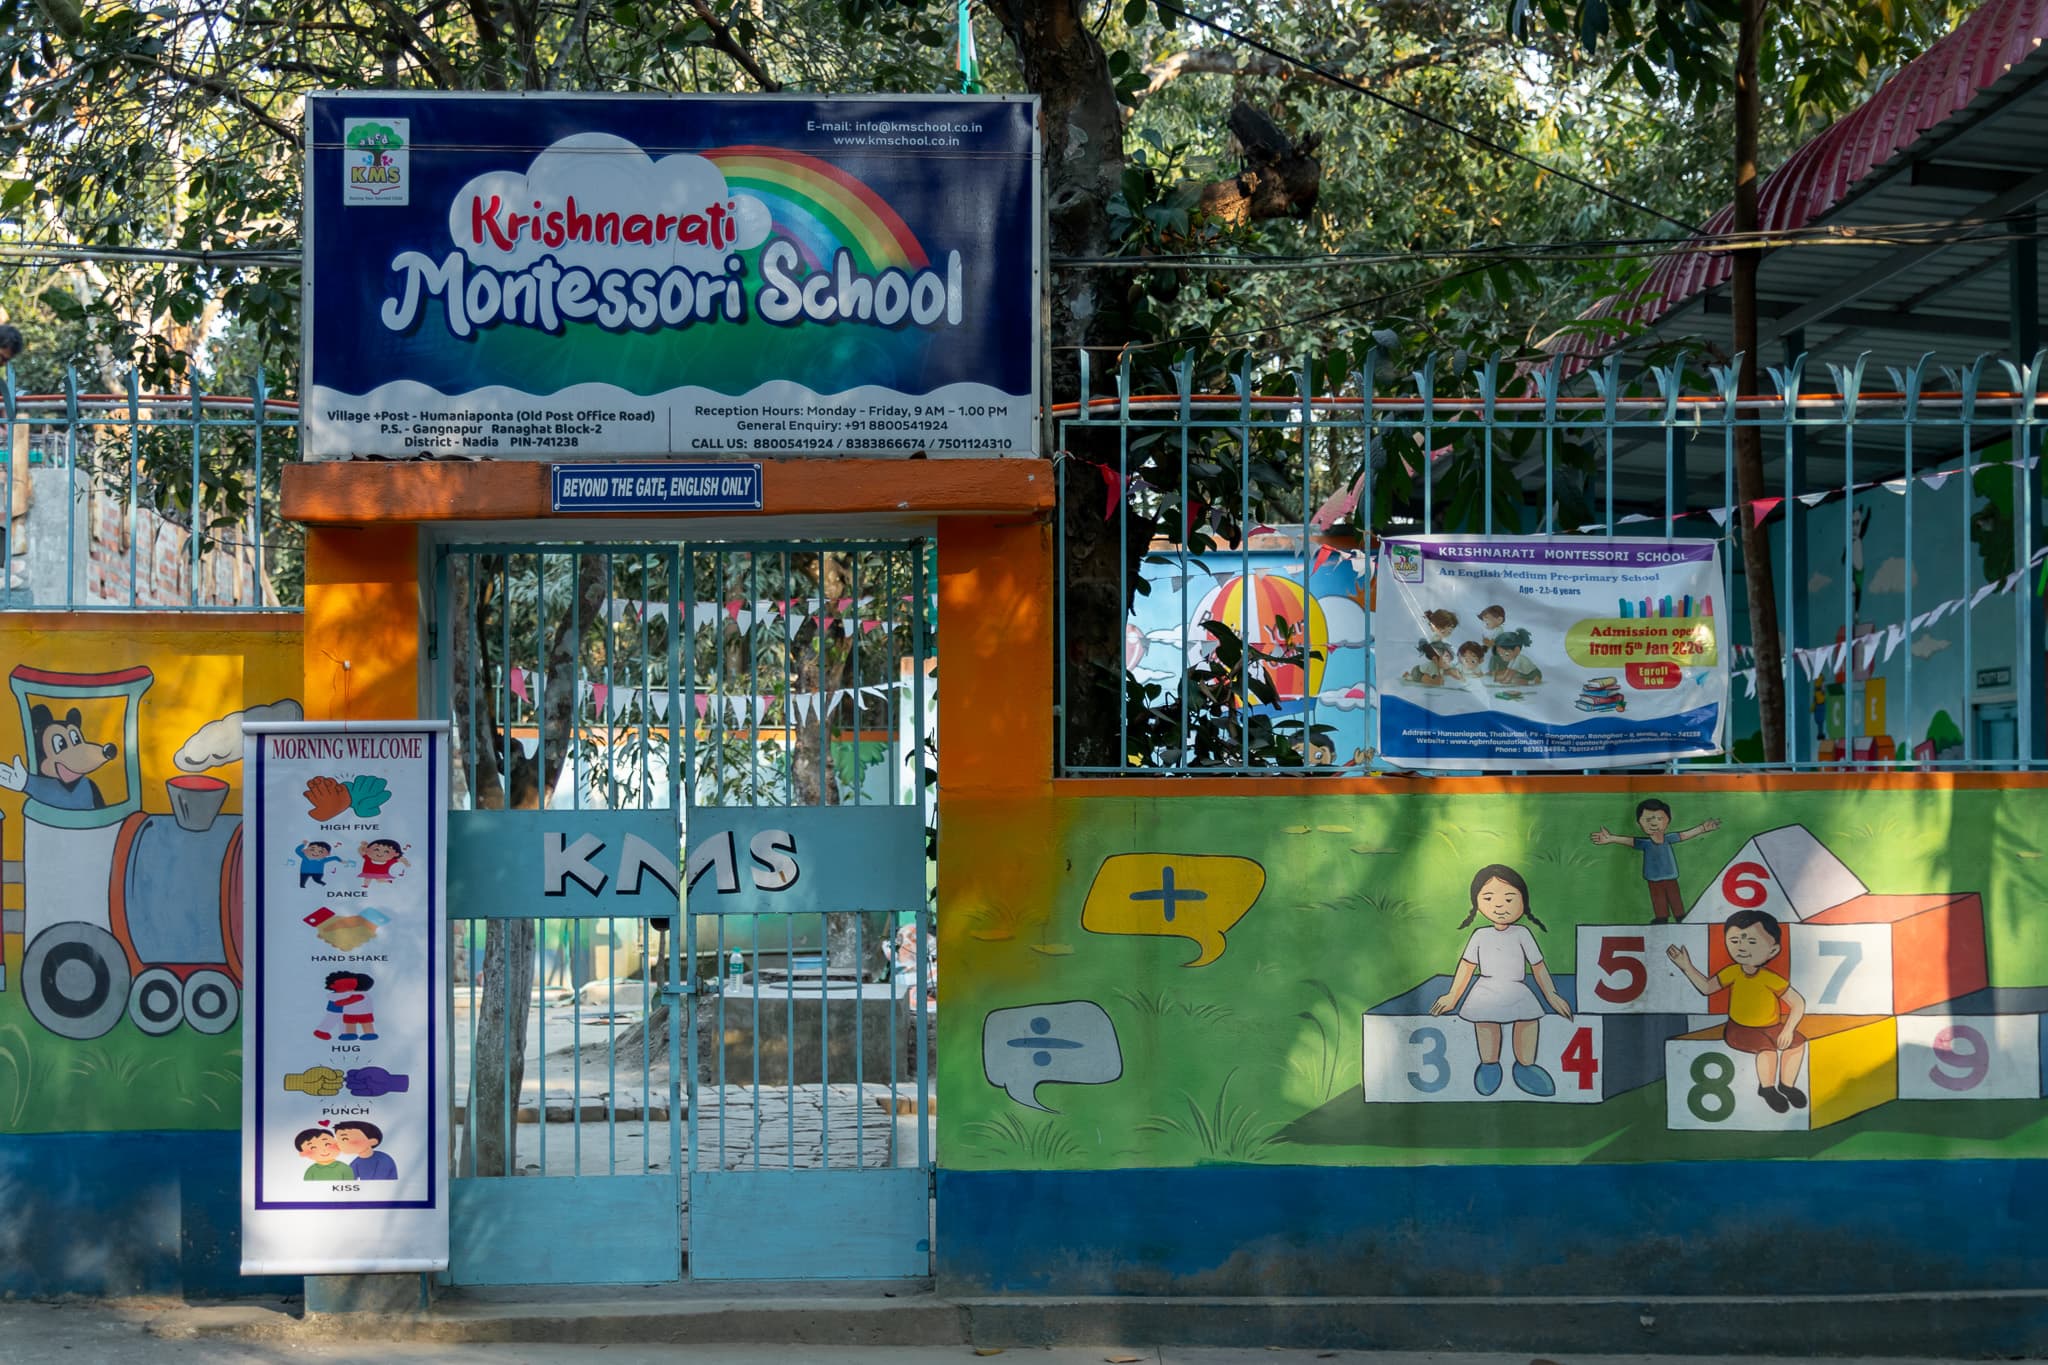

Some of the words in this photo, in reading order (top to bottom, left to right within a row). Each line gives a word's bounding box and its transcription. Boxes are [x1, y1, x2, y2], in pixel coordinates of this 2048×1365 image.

[807, 121, 852, 132] E-mail:
[855, 121, 983, 134] info@kmschool.co.in
[833, 136, 961, 147] www.kmschool.co.in
[351, 166, 401, 184] KMS
[471, 195, 737, 251] Krishnarati
[382, 251, 742, 336] Montessori
[759, 240, 963, 325] School
[327, 410, 371, 424] Village
[373, 411, 410, 422] +Post
[420, 410, 514, 424] Humaniaponta
[516, 410, 543, 424] (Old
[545, 411, 574, 422] Post
[575, 410, 617, 422] Office
[619, 410, 656, 424] Road)
[695, 406, 759, 419] Reception
[762, 406, 804, 417] Hours:
[807, 406, 857, 418] Monday
[869, 406, 912, 418] Friday,
[914, 406, 922, 417] 9
[925, 406, 945, 417] AM
[959, 406, 985, 417] 1.00
[988, 406, 1007, 417] PM
[381, 424, 402, 435] P.S.
[412, 423, 483, 437] Gangnapur
[491, 423, 553, 437] Ranaghat
[555, 423, 602, 435] Block-2
[737, 420, 786, 431] General
[789, 420, 842, 433] Enquiry:
[845, 420, 866, 431] +91
[869, 420, 949, 431] 8800541924
[405, 436, 452, 448] District
[463, 436, 499, 448] Nadia
[510, 436, 579, 448] PIN-741238
[692, 438, 724, 449] CALL
[727, 438, 748, 449] US:
[753, 438, 834, 449] 8800541924
[846, 438, 926, 449] 8383866674
[938, 438, 1012, 449] 7501124310
[562, 478, 609, 498] BEYOND
[611, 477, 634, 498] THE
[635, 477, 669, 501] GATE,
[670, 476, 719, 497] ENGLISH
[721, 476, 753, 497] ONLY
[1438, 547, 1535, 559] KRISHNARATI
[1545, 549, 1629, 561] MONTESSORI
[1636, 552, 1688, 562] SCHOOL
[1439, 567, 1455, 577] An
[1457, 568, 1501, 579] English
[1503, 569, 1547, 580] Medium
[1550, 572, 1619, 583] Pre-primary
[1621, 573, 1660, 582] School
[1519, 585, 1534, 594] Age
[1559, 588, 1581, 596] years
[1590, 626, 1668, 637] Admission
[1589, 641, 1622, 655] from
[1645, 641, 1669, 655] Jan
[1639, 665, 1668, 676] Enroll
[1643, 676, 1664, 685] Now
[271, 738, 344, 760] MORNING
[346, 737, 423, 759] WELCOME
[353, 823, 380, 831] FIVE
[543, 829, 801, 900] KMS
[1722, 862, 1771, 908] 6
[1594, 936, 1648, 1003] 5
[1818, 940, 1863, 1004] 7
[1407, 1027, 1451, 1093] 3
[1560, 1027, 1599, 1090] 4
[1929, 1024, 1989, 1091] 9
[1687, 1052, 1736, 1122] 8
[322, 1107, 370, 1116] PUNCH
[332, 1184, 361, 1192] KISS
